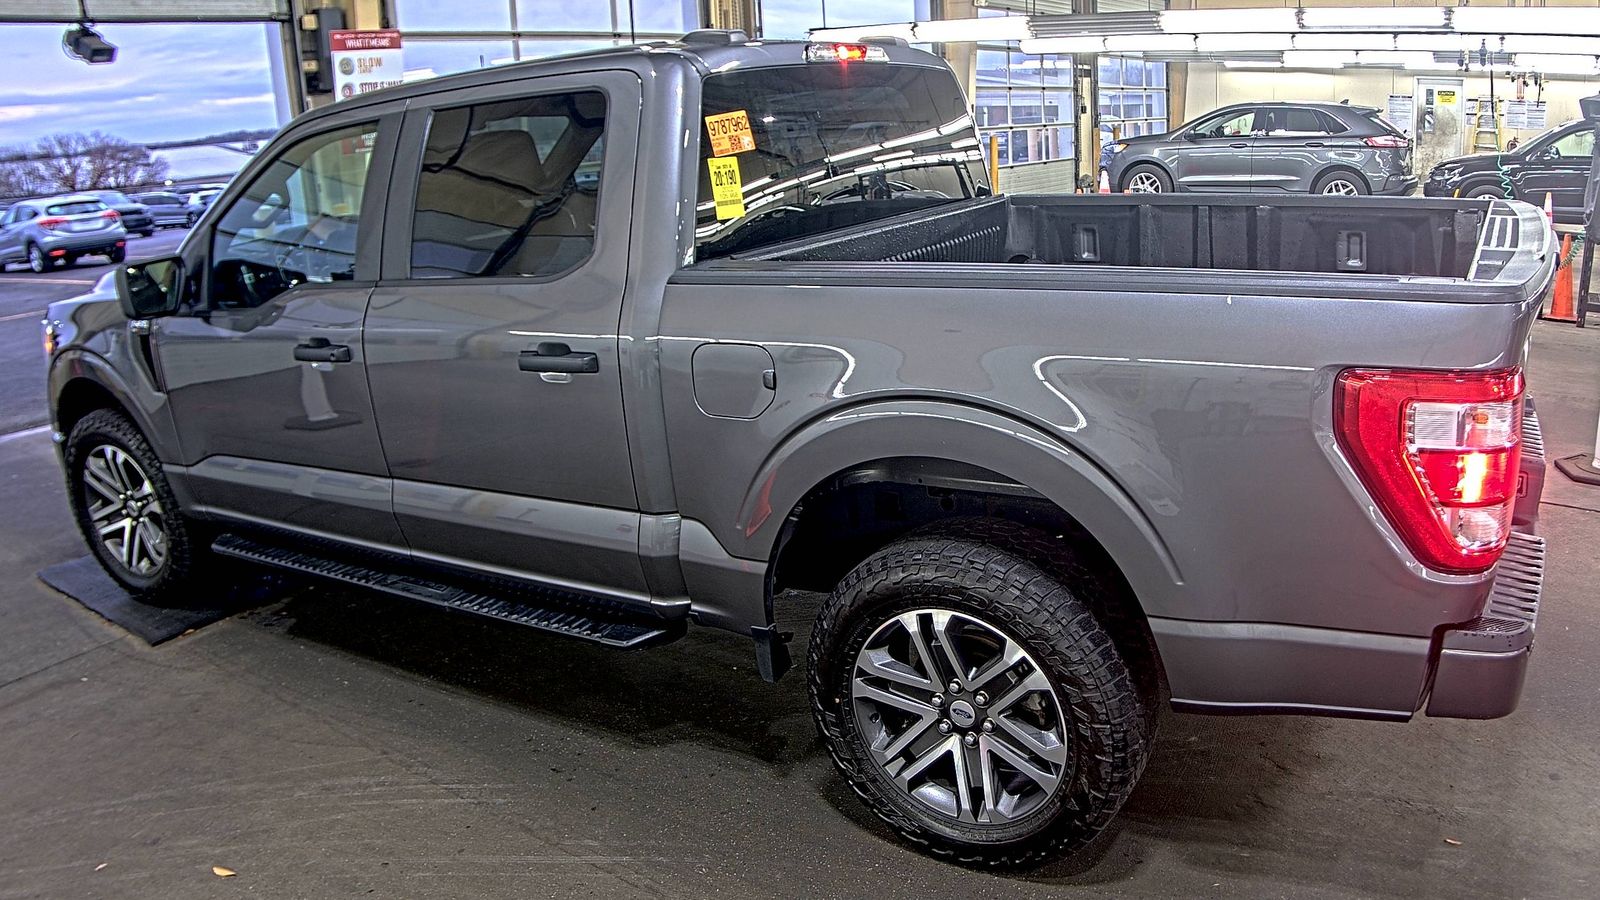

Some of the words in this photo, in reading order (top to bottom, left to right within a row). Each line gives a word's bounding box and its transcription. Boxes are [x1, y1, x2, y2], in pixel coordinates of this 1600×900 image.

[345, 39, 361, 48] WHAT
[357, 57, 383, 68] SLOW
[709, 115, 749, 136] 9787962
